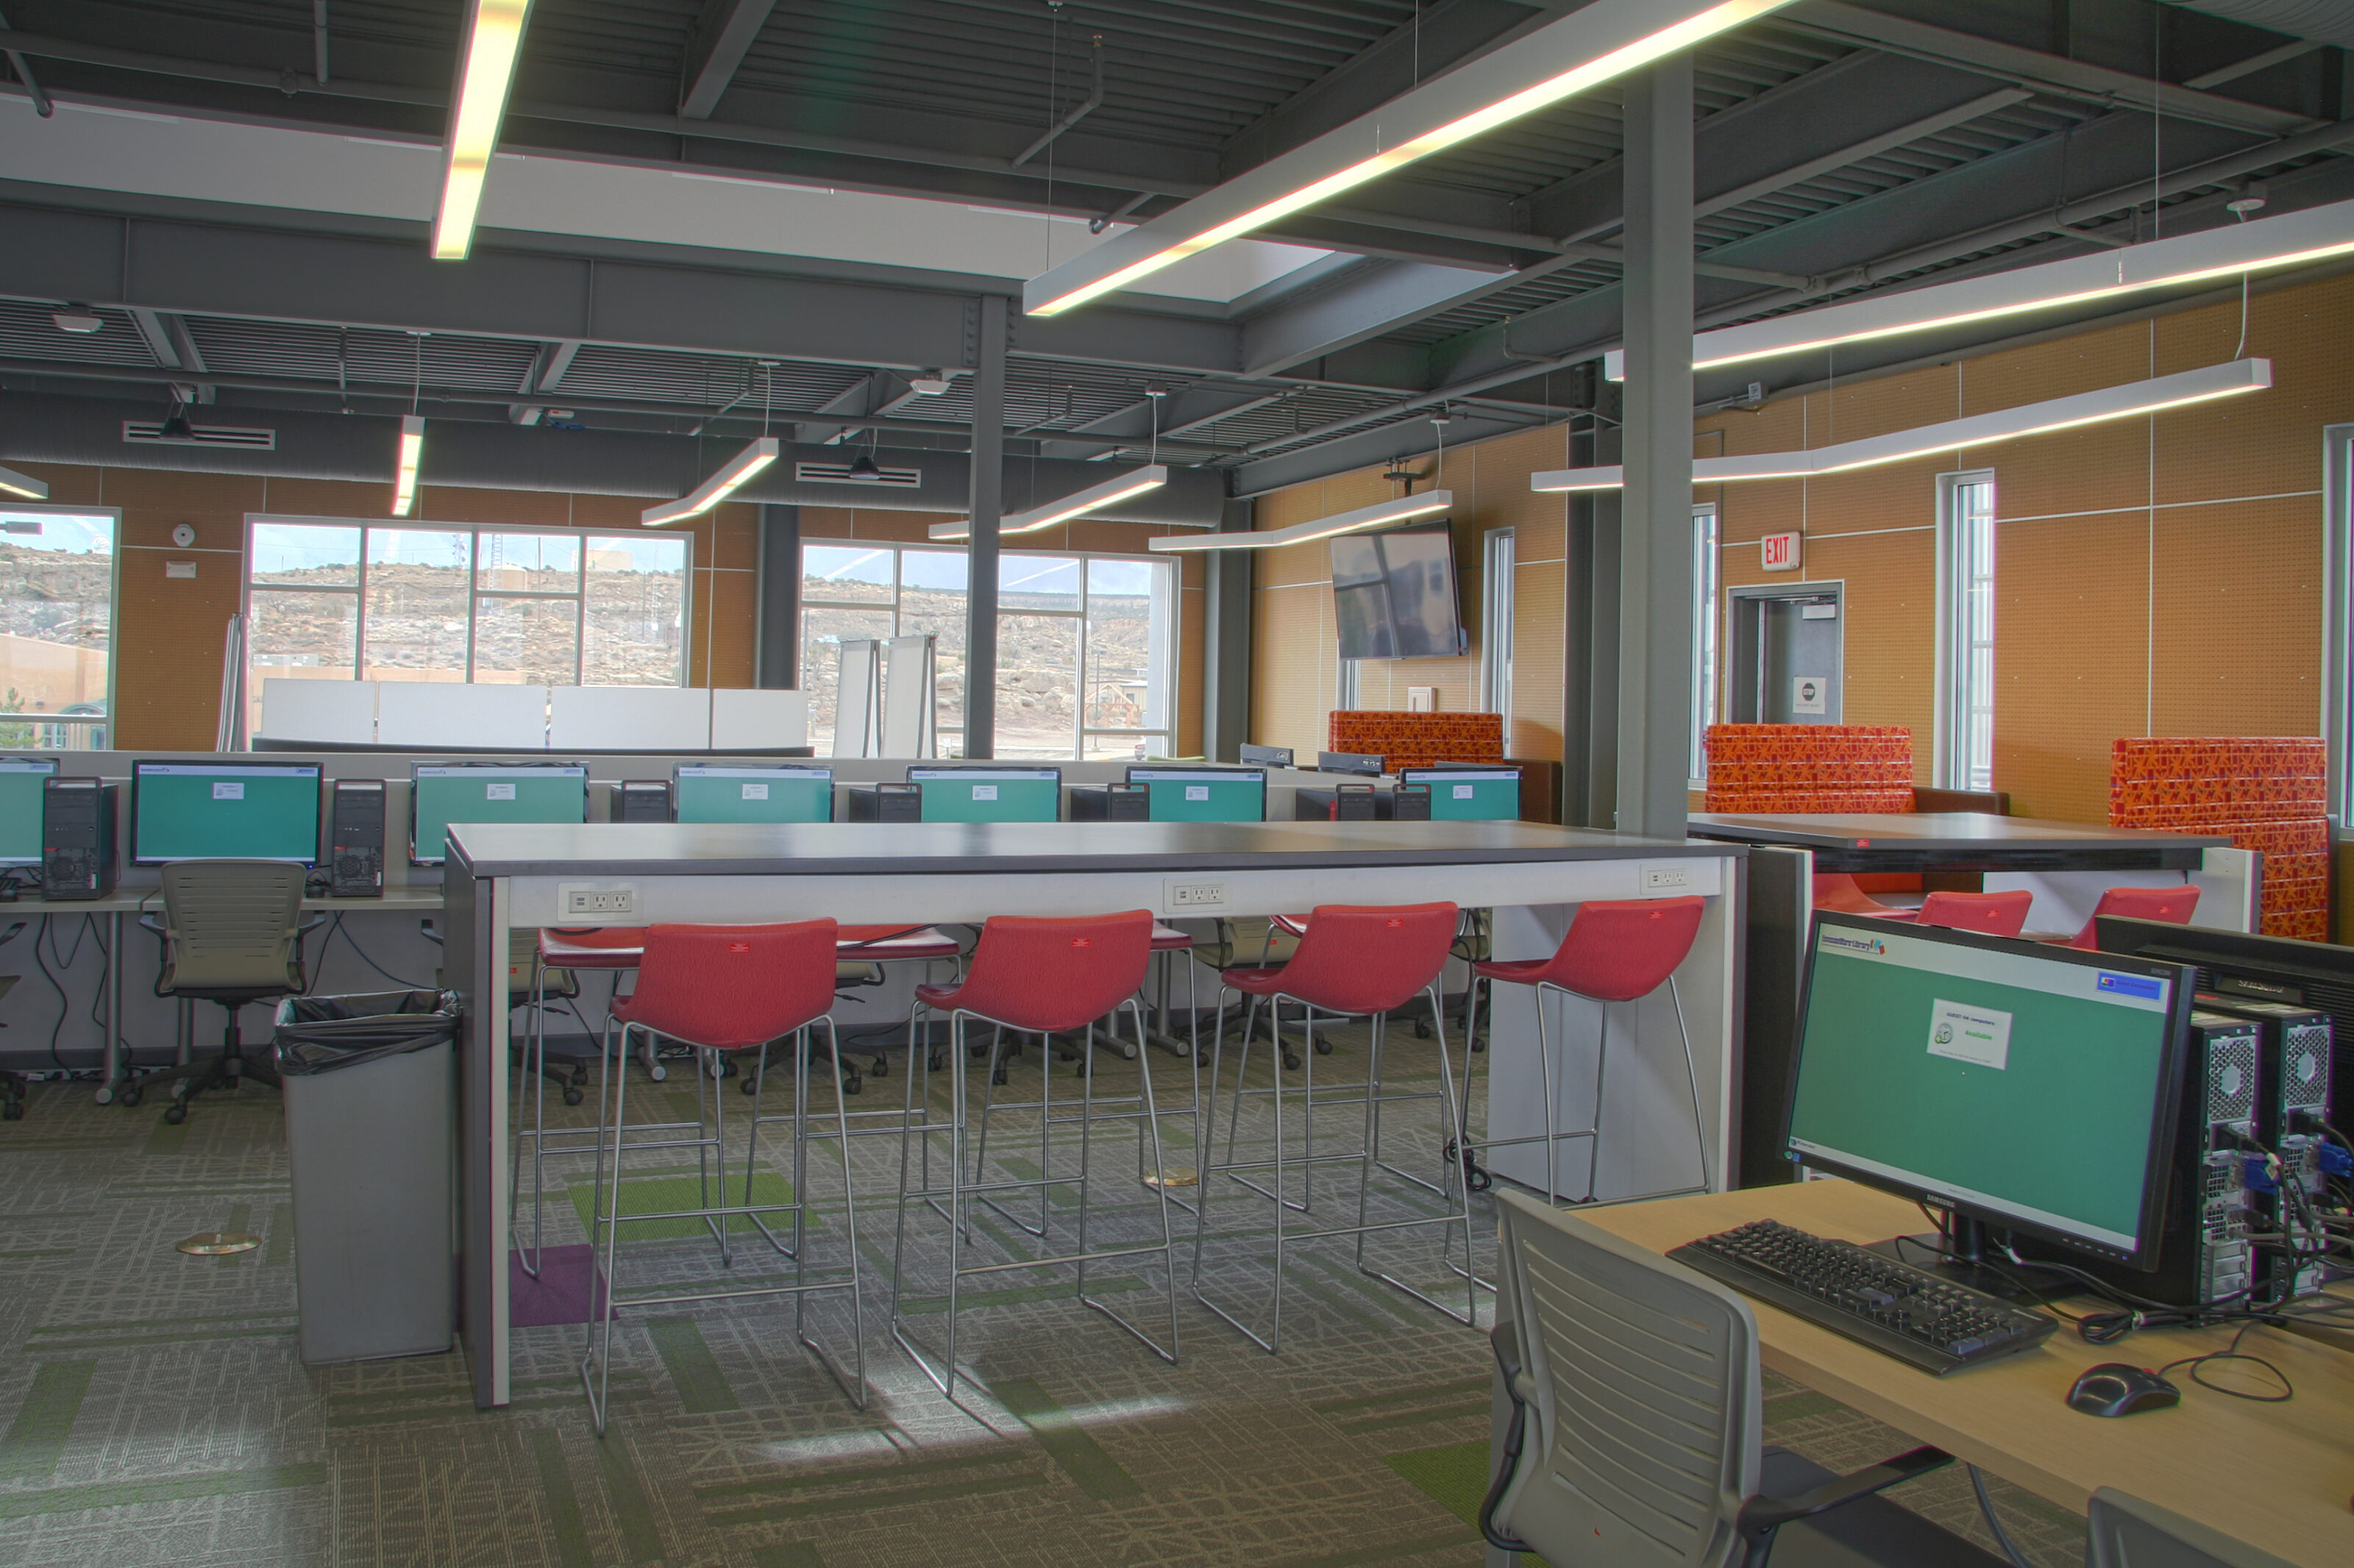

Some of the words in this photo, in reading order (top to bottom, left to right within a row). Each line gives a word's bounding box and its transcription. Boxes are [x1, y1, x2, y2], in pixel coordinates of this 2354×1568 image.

[1766, 536, 1789, 564] EXIT
[2238, 980, 2285, 994] SAMSUNG
[1964, 1030, 1993, 1041] Available
[1927, 1194, 1955, 1208] SAMSUNG
